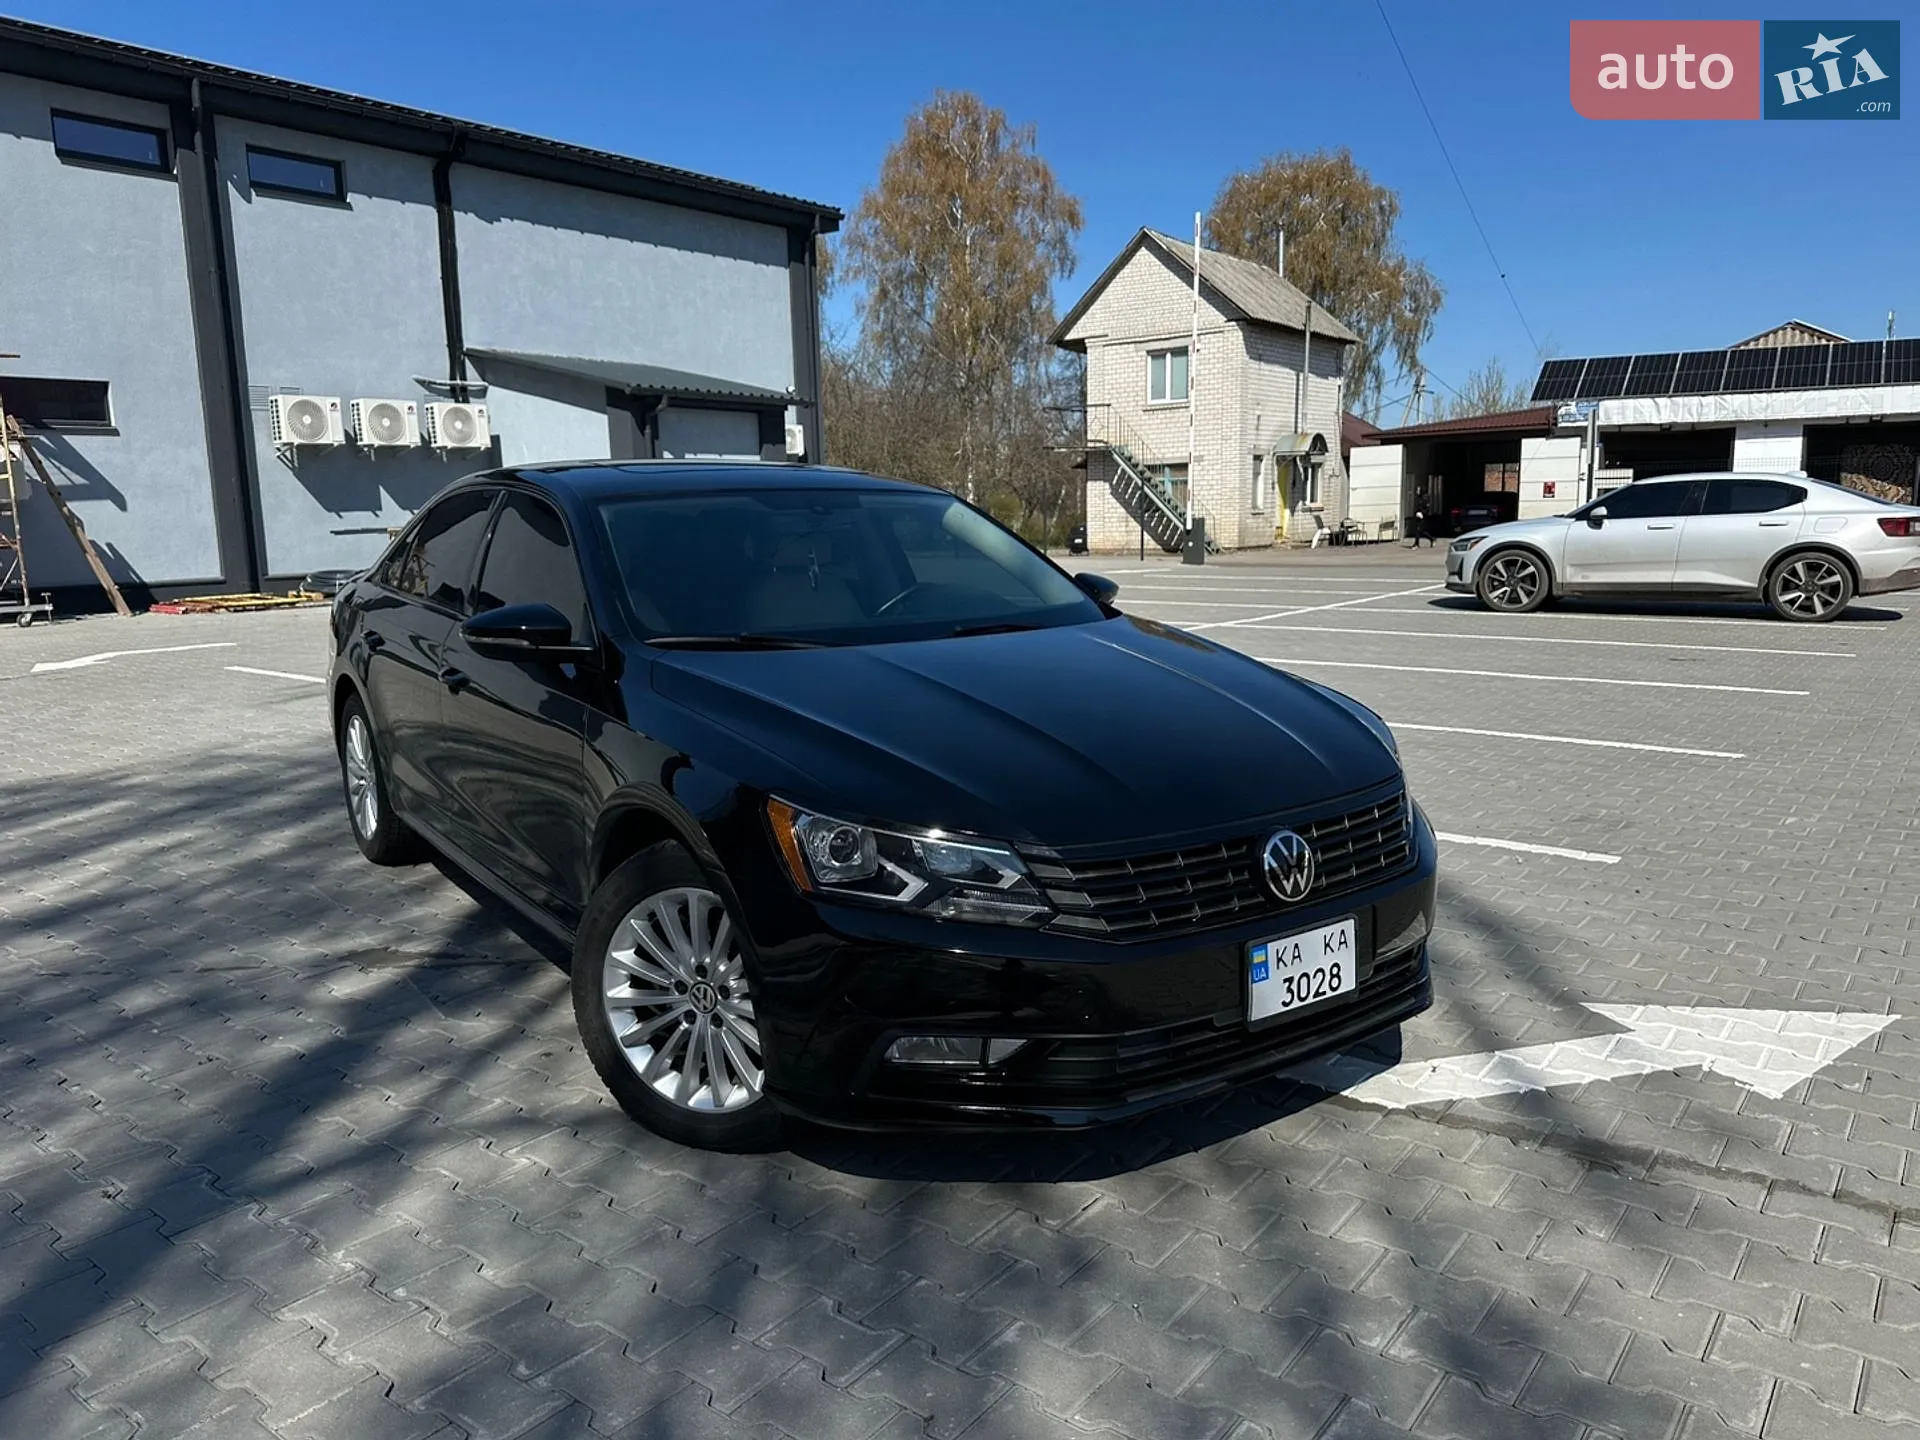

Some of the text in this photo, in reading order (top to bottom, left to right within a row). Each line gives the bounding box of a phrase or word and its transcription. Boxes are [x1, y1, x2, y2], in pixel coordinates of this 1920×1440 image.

[1275, 929, 1349, 970] KA KA
[1252, 966, 1268, 981] UA
[1281, 962, 1342, 1008] 3028
